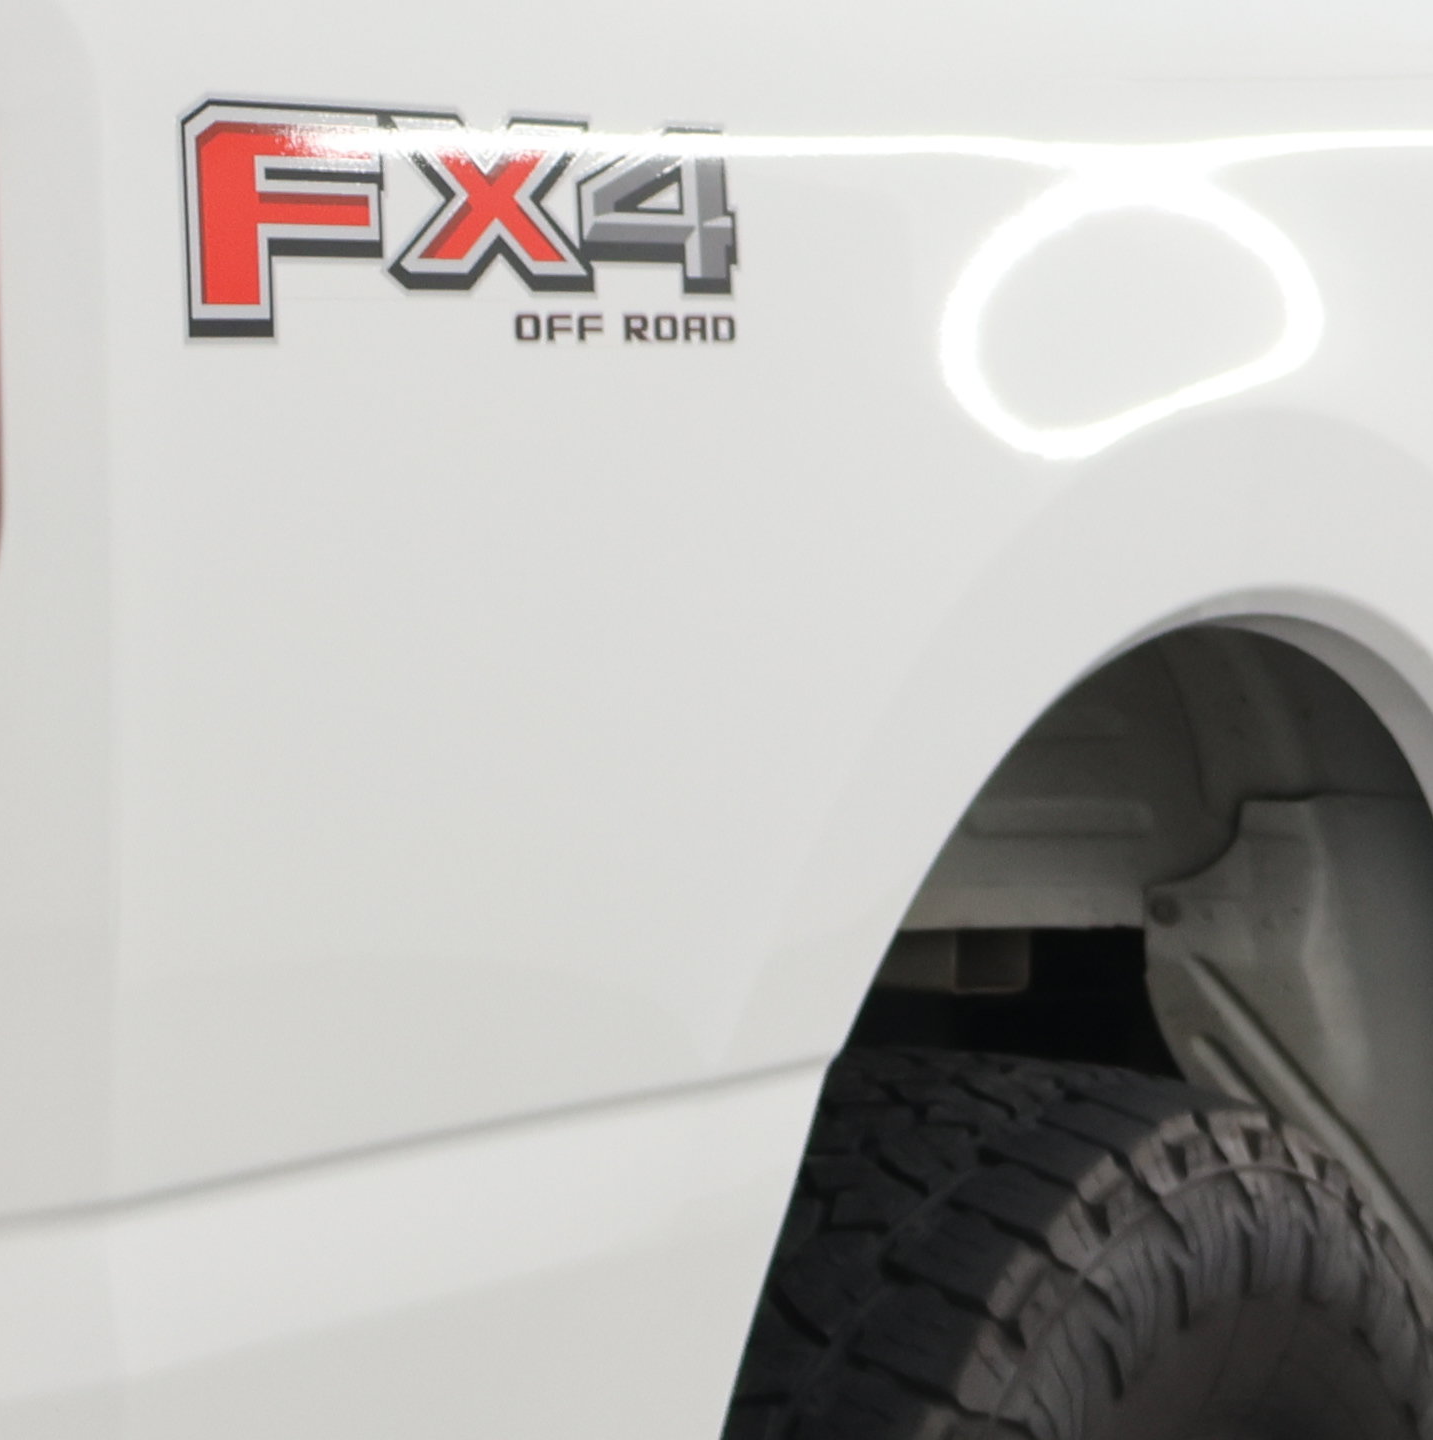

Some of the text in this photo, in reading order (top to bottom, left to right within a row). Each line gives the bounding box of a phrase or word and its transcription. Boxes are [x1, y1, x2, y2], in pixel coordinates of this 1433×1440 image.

[178, 97, 738, 339] FX4
[514, 313, 737, 343] OFF ROAD
